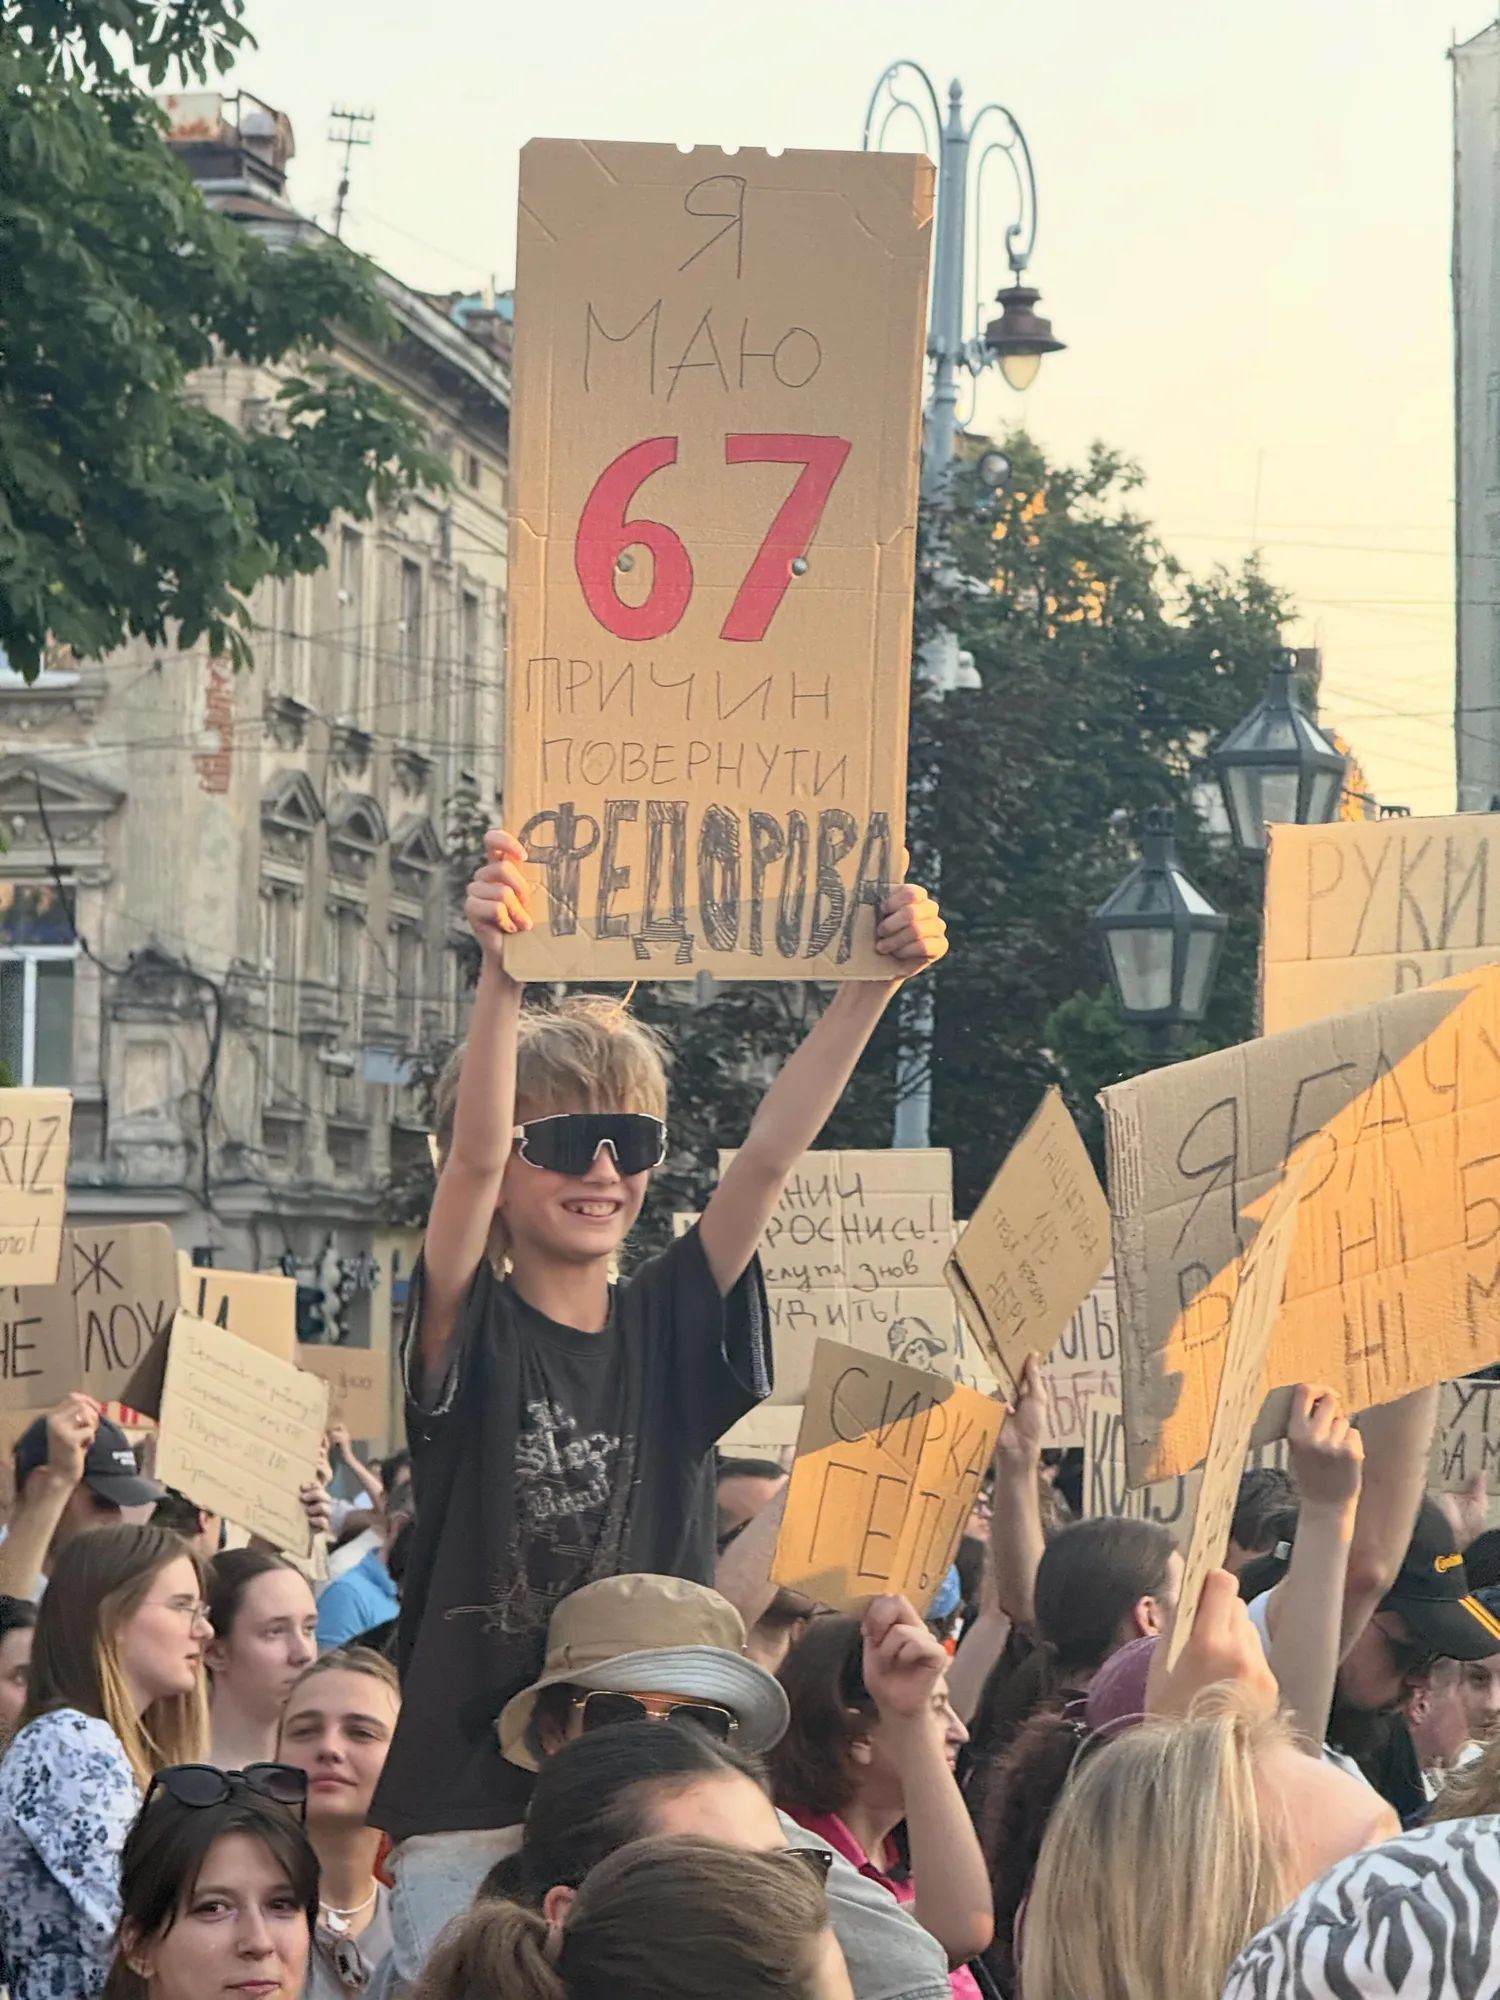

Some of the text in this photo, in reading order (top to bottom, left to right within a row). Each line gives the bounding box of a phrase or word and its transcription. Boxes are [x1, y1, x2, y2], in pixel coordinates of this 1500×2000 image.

[678, 174, 747, 280] Я
[583, 299, 822, 403] МАЮ
[574, 432, 853, 642] 67
[526, 657, 831, 721] ПРИЧИН
[541, 738, 848, 797] ПОВЕРНУТИ
[517, 799, 893, 965] ФЕДОРОВА
[1306, 836, 1490, 961] РУКИ
[757, 1194, 940, 1250] РОСНИСЬ!
[1171, 1096, 1239, 1259] Я
[830, 1366, 989, 1496] СИРКА
